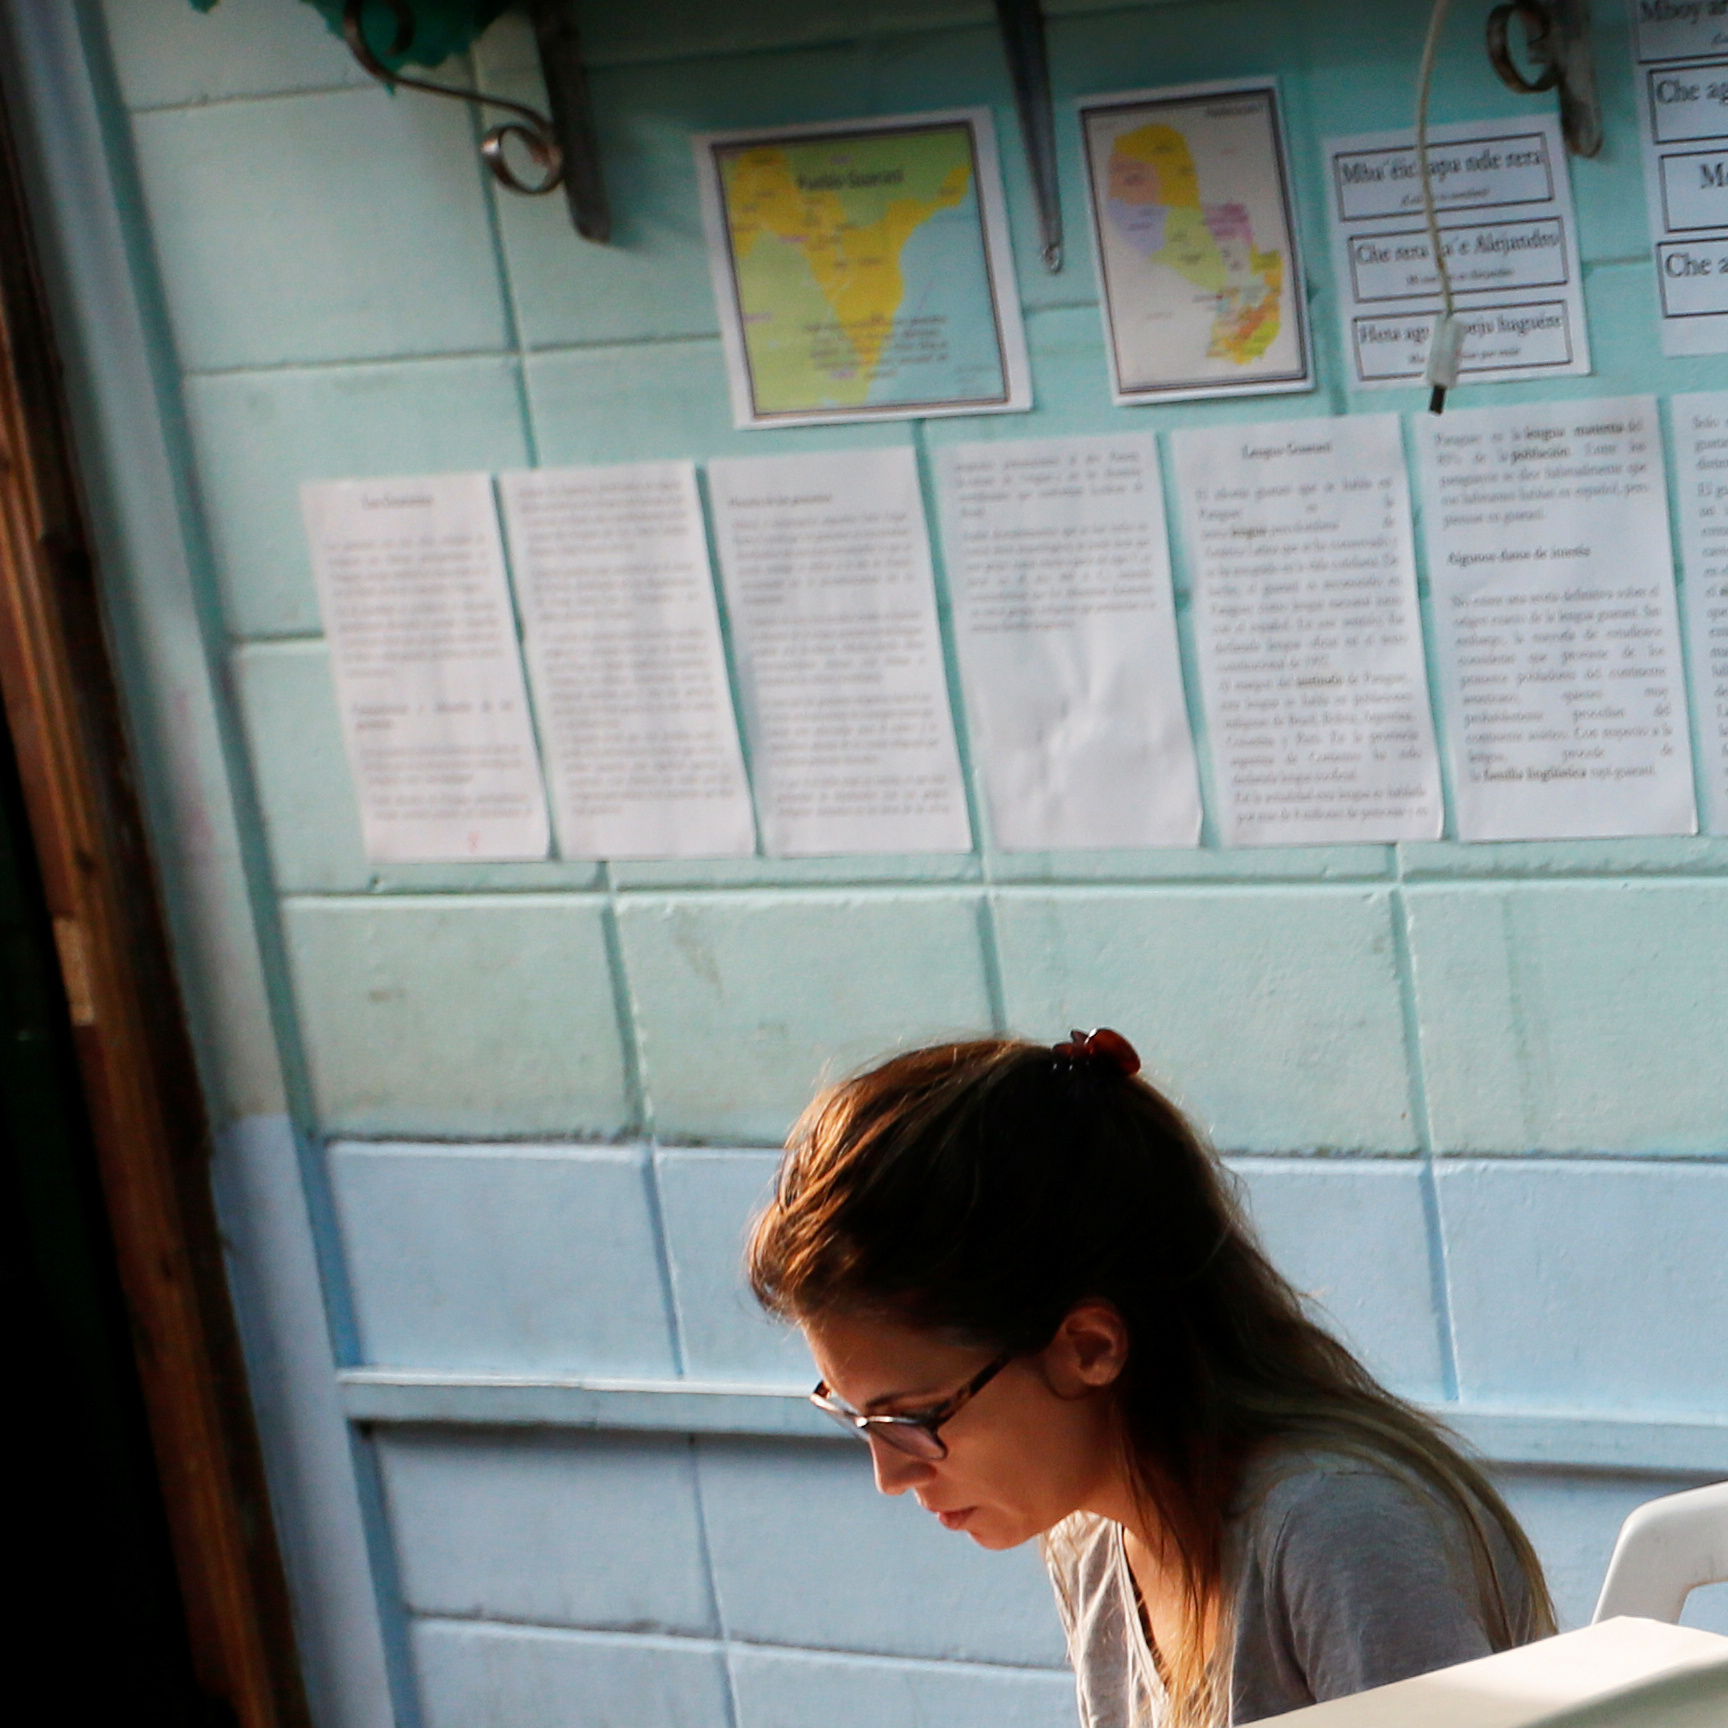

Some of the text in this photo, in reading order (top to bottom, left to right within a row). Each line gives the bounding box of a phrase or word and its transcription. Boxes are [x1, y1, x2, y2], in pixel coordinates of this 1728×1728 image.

[1655, 79, 1700, 104] Che
[1356, 243, 1389, 264] Che
[1475, 228, 1560, 257] Alejandro
[1665, 251, 1713, 279] Che
